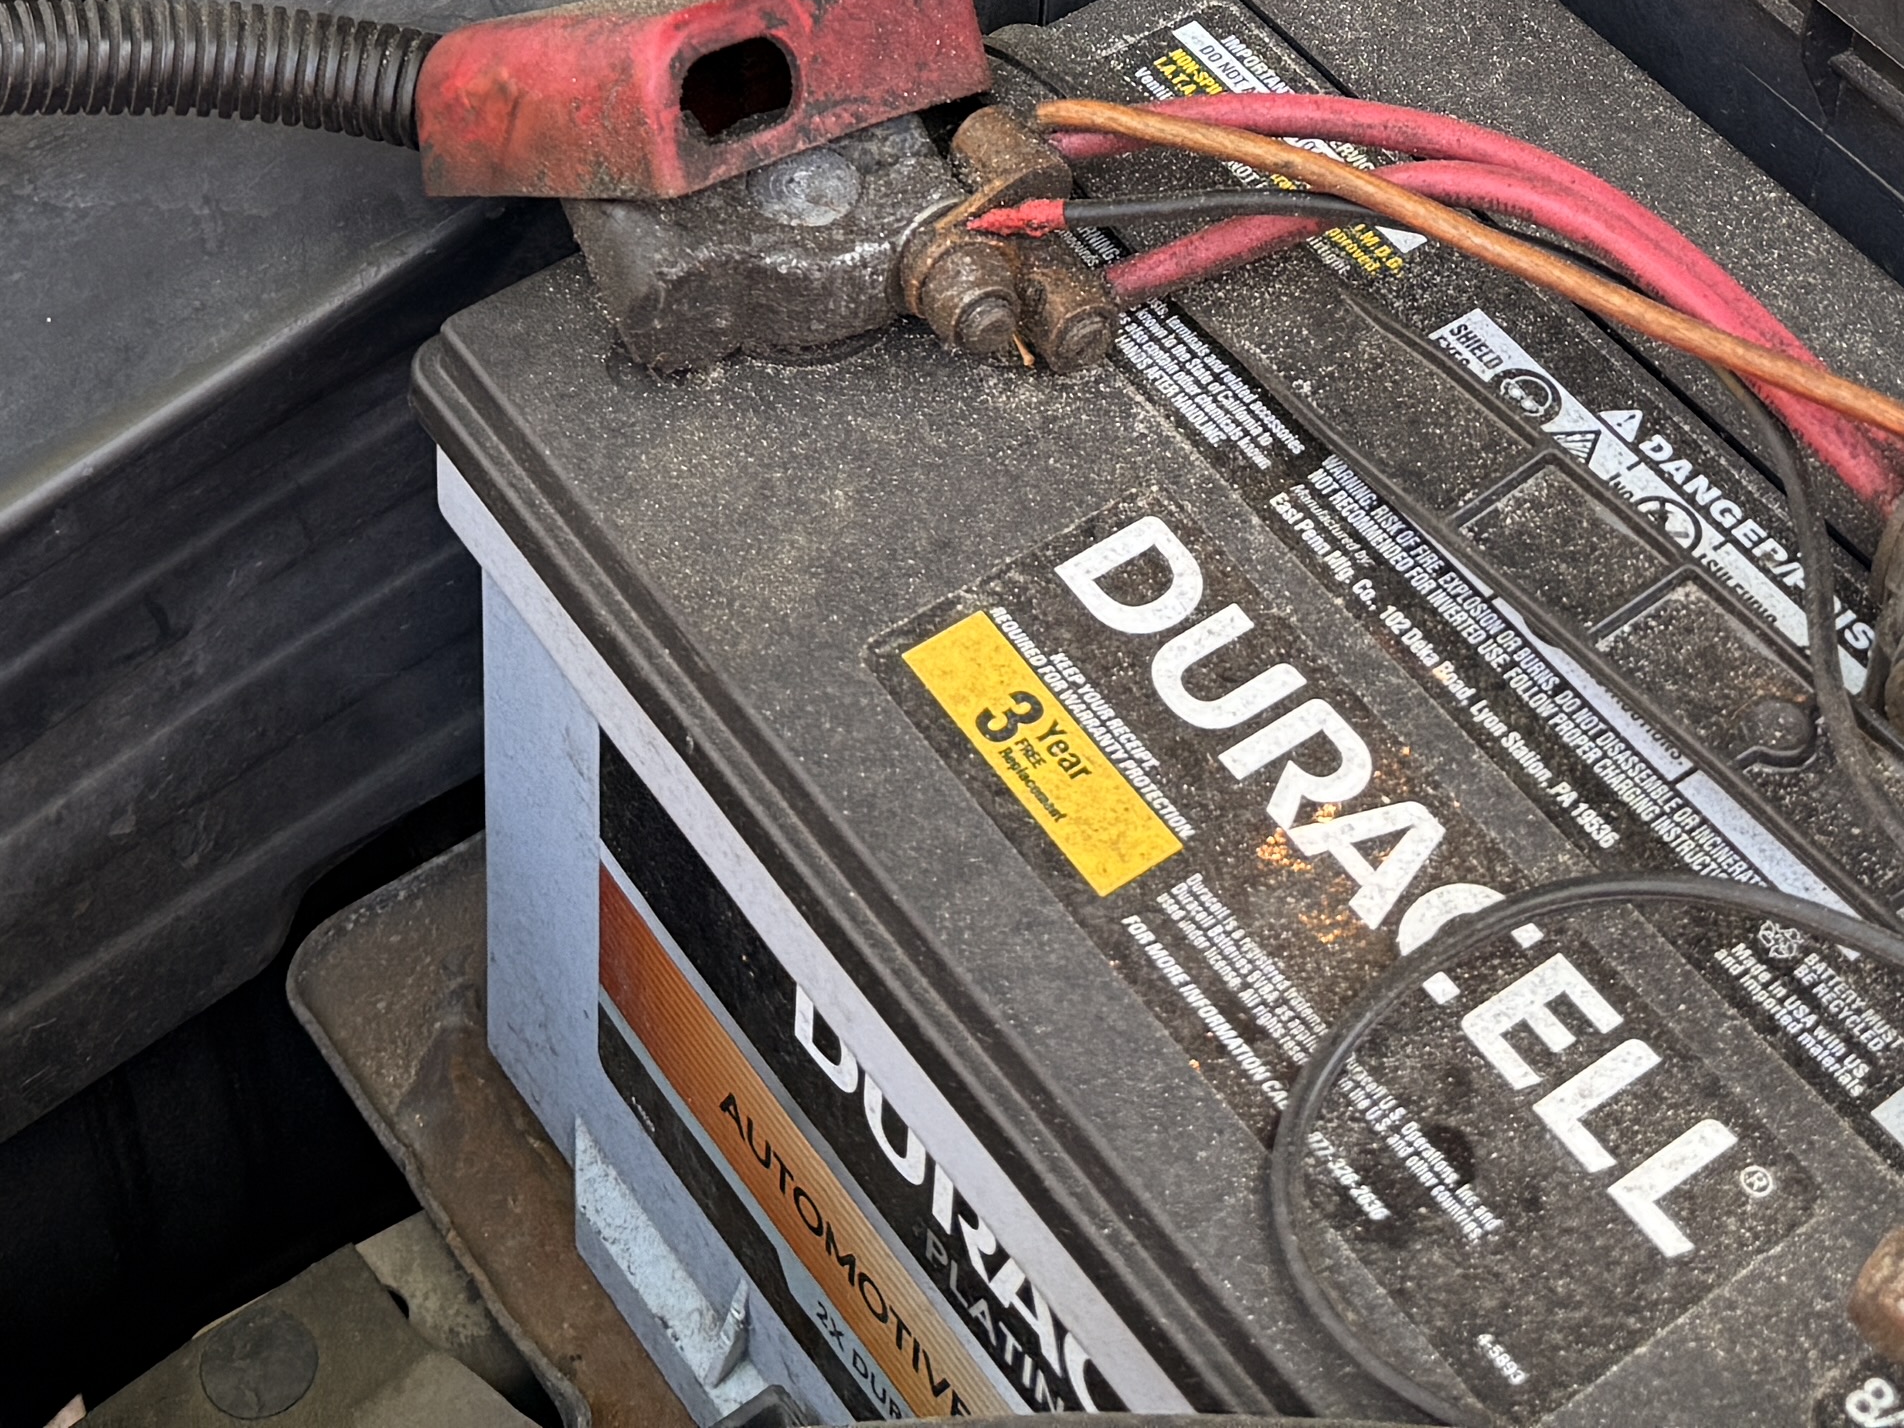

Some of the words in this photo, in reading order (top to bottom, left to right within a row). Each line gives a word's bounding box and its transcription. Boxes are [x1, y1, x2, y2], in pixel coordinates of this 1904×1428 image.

[1198, 44, 1226, 66] DO
[1216, 61, 1248, 87] NOT
[1221, 33, 1295, 101] IMPORTAN
[1113, 331, 1150, 370] HANDS
[1142, 361, 1179, 399] AFTER
[1169, 388, 1227, 449] HANDLING.
[1447, 321, 1507, 372] SHIELD
[1288, 482, 1363, 552] Manufactured
[1352, 549, 1376, 568] by:
[1266, 491, 1307, 525] East
[1291, 517, 1336, 556] Penn
[1318, 549, 1364, 586] Mfg.
[1347, 577, 1390, 612] Co.,
[1375, 604, 1413, 635] 102
[1397, 627, 1445, 667] Deka
[1464, 699, 1512, 739] Lyon
[1496, 731, 1562, 788] Station,
[1546, 781, 1581, 807] PA
[1566, 801, 1622, 850] 19536
[1305, 468, 1338, 496] NOT
[1327, 490, 1415, 573] RECOMMENDED
[1402, 566, 1438, 595] FOR
[1424, 589, 1487, 646] INVERTED
[1474, 639, 1514, 672] USE.
[1501, 666, 1559, 718] FOLLOW
[1546, 712, 1605, 764] PROPER
[1590, 757, 1661, 822] CHARGING
[1319, 453, 1382, 510] WARNING:
[1368, 504, 1406, 536] RISK
[1393, 529, 1421, 550] OF
[1435, 571, 1507, 636] EXPLOSION
[1493, 628, 1525, 653] OR
[1509, 646, 1566, 695] BURNS.
[1552, 689, 1583, 714] DO
[1569, 707, 1605, 736] NOT
[1594, 731, 1683, 813] DISASSEMBLE
[1669, 806, 1703, 831] OR
[974, 689, 1046, 745] 3
[987, 603, 1050, 668] REQUIRED
[1037, 662, 1070, 693] FOR
[1058, 687, 1131, 763] WARRANTY
[1118, 758, 1197, 841] PROTECTION.
[1011, 736, 1048, 770] FREE
[1033, 719, 1097, 782] Year
[1048, 650, 1087, 687] KEEP
[1075, 682, 1115, 720] YOUR
[1104, 715, 1160, 772] RECEIPT.
[996, 745, 1068, 823] Replacement
[1053, 513, 1741, 1258] DURACELL
[1119, 912, 1157, 946] FOR
[1143, 940, 1191, 987] MORE
[1177, 981, 1273, 1082] INFORMATION
[1711, 947, 1747, 976] and
[1736, 974, 1803, 1034] imported
[1794, 1031, 1867, 1097] materials
[1727, 942, 1777, 984] Made
[1765, 980, 1792, 1000] in
[1781, 996, 1821, 1028] USA
[1809, 1024, 1850, 1058] with
[1839, 1054, 1873, 1080] US
[1791, 964, 1822, 988] BE
[1809, 983, 1892, 1057] RECYCLED.
[1800, 952, 1867, 1011] BATTERY
[719, 1092, 972, 1418] AUTOMOTIVE
[815, 1299, 846, 1344] 2X
[1472, 1330, 1529, 1387] 4-5893
